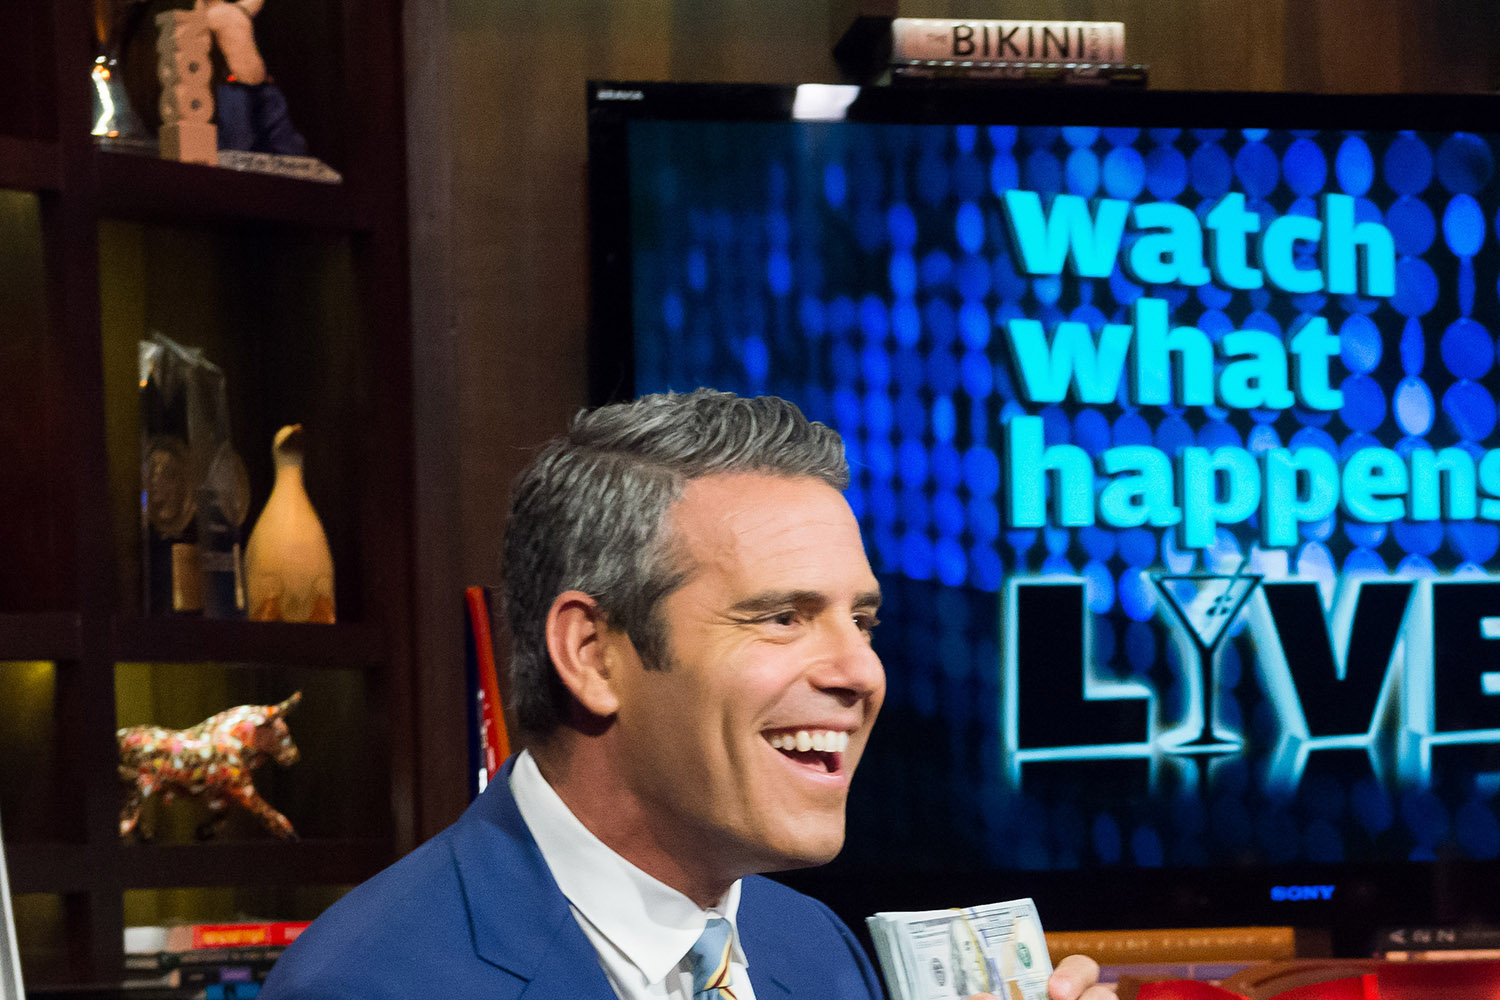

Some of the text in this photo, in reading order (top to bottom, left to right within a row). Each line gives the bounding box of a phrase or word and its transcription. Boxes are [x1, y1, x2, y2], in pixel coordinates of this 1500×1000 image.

[952, 24, 1085, 58] BIKINI
[1005, 189, 1397, 297] watch
[1008, 298, 1344, 411] what
[1270, 885, 1336, 901] SONY
